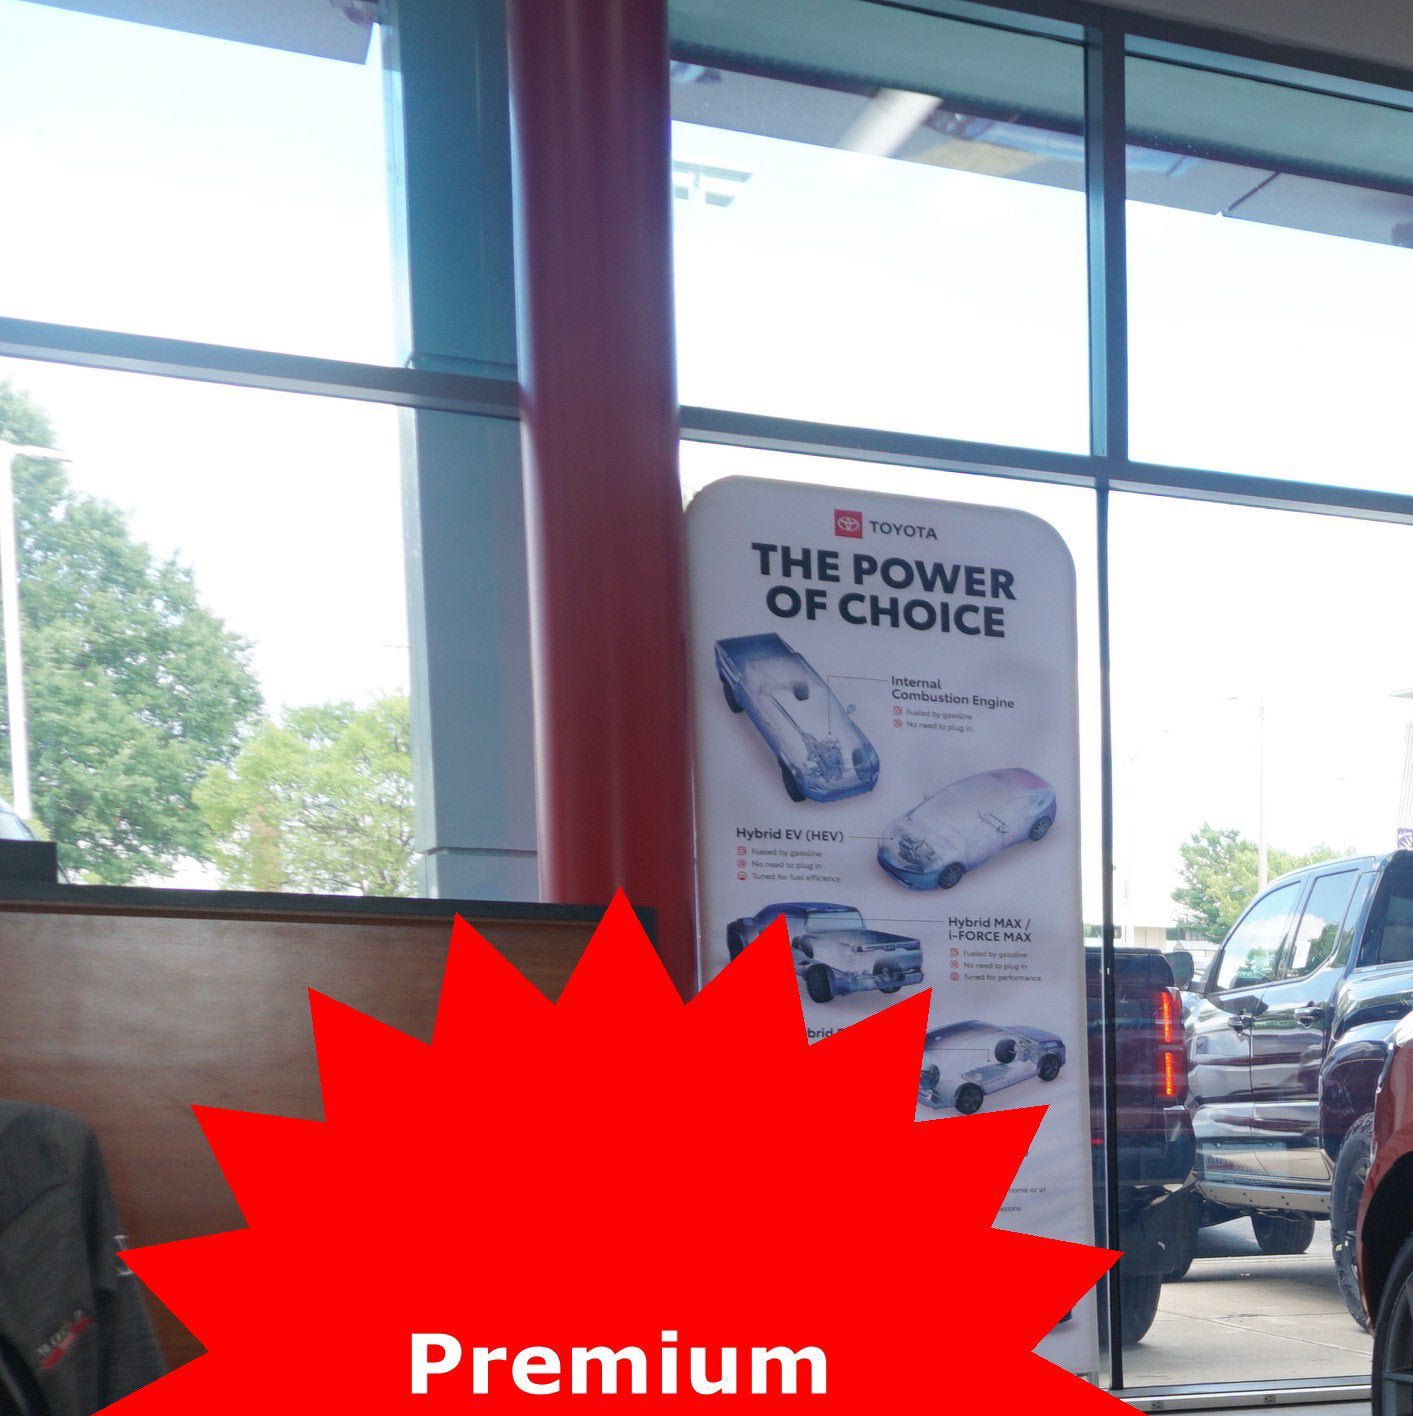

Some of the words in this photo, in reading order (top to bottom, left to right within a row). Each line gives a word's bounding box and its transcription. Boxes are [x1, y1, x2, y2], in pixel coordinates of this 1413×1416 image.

[869, 520, 938, 540] TOYOTA
[751, 543, 840, 582] THE
[853, 553, 1017, 600] POWER
[766, 585, 828, 620] OF
[838, 592, 1005, 638] CHOICE
[891, 675, 942, 690] Internal
[891, 689, 969, 705] Combustion
[973, 695, 1015, 709] Engine
[932, 711, 940, 719] by
[919, 722, 937, 730] need
[947, 723, 964, 733] plug
[736, 827, 781, 841] Hybrid
[786, 829, 802, 840] EV
[806, 829, 844, 843] (HEV)
[778, 848, 788, 857] by
[752, 860, 762, 868] No
[796, 862, 813, 870] plug
[948, 917, 990, 930] Hybrid
[994, 918, 1021, 929] MAX
[1025, 919, 1031, 930] /
[948, 930, 1000, 942] i-FORCE
[1004, 932, 1032, 943] MAX
[988, 951, 997, 959] by
[976, 962, 993, 970] need
[1004, 962, 1019, 971] plug
[997, 974, 1042, 982] performance
[807, 1027, 833, 1038] brid
